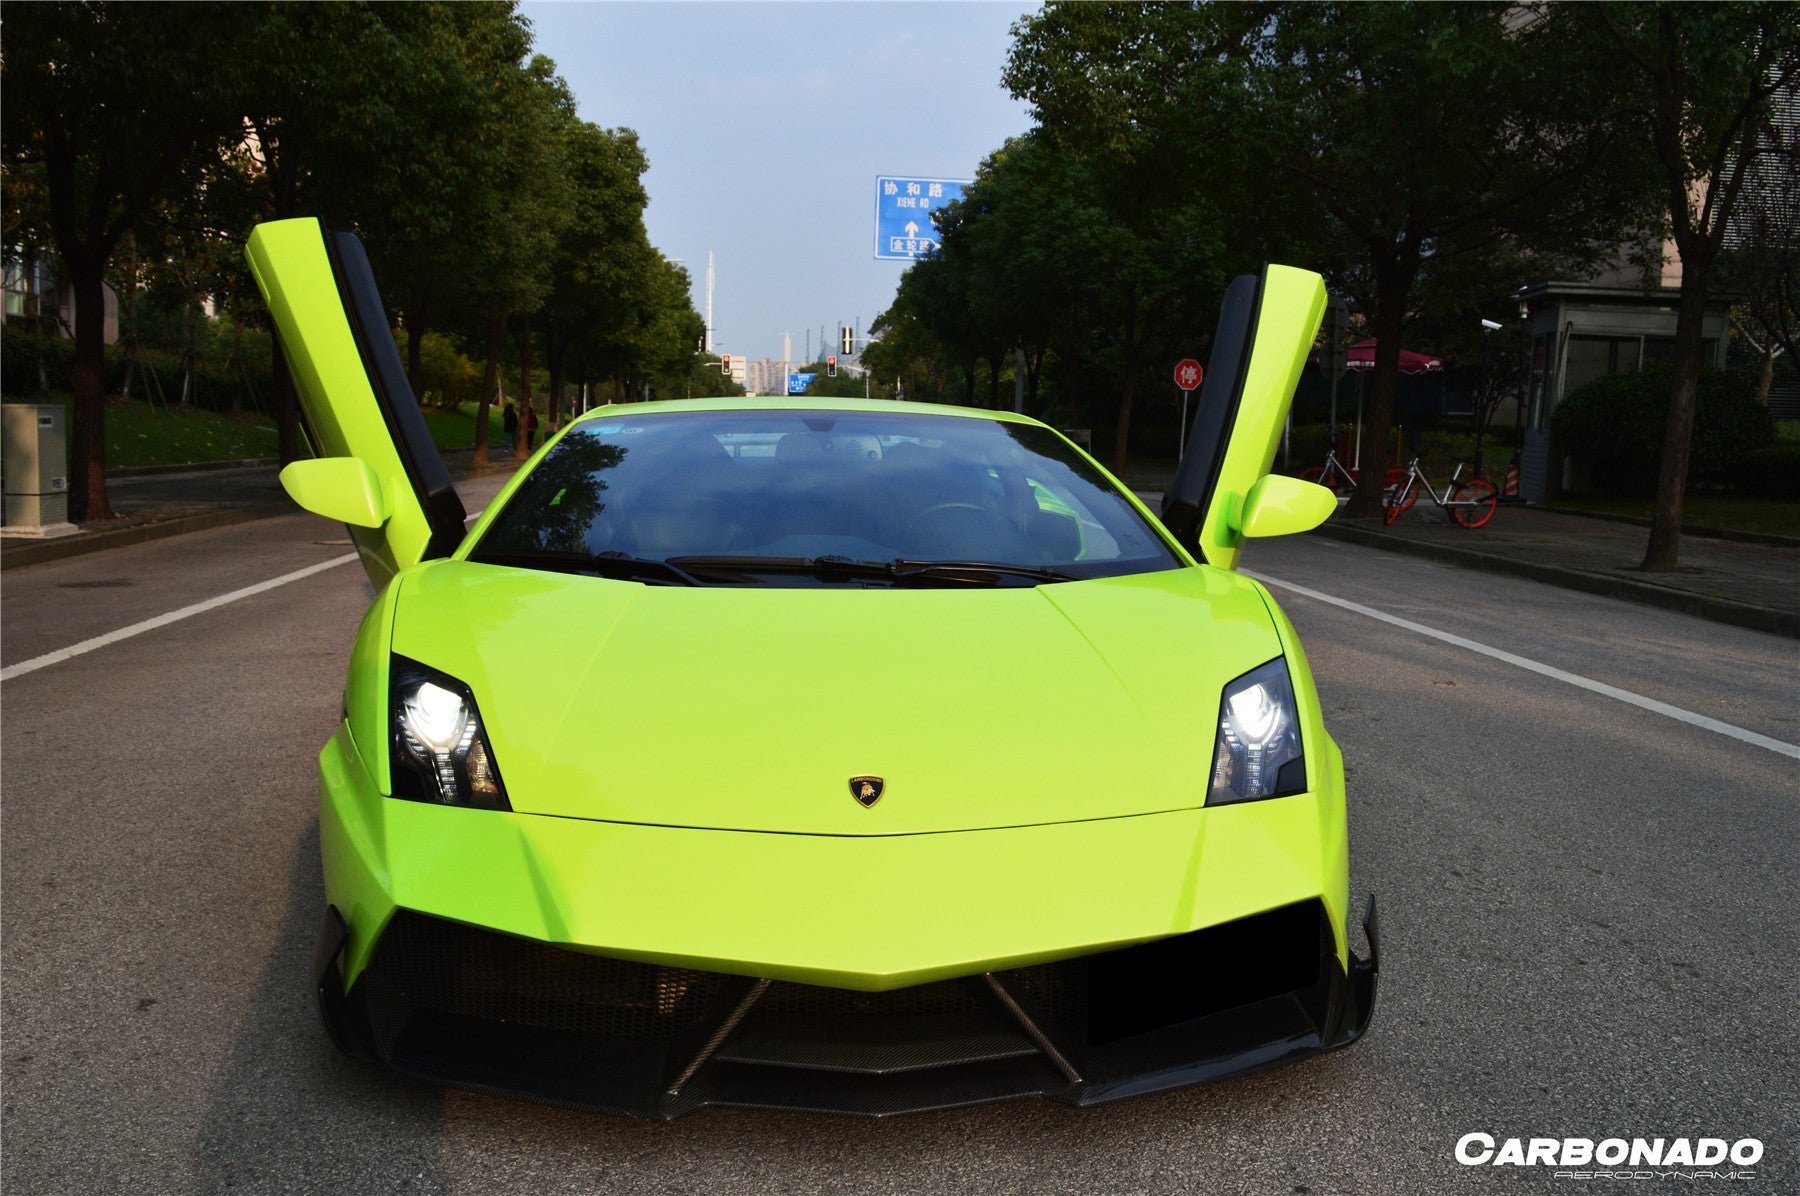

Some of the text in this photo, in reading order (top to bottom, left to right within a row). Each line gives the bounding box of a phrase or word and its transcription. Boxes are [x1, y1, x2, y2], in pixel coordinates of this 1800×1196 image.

[884, 181, 942, 197] 协和路
[897, 197, 929, 208] XIEHE RD
[1180, 365, 1198, 385] 停
